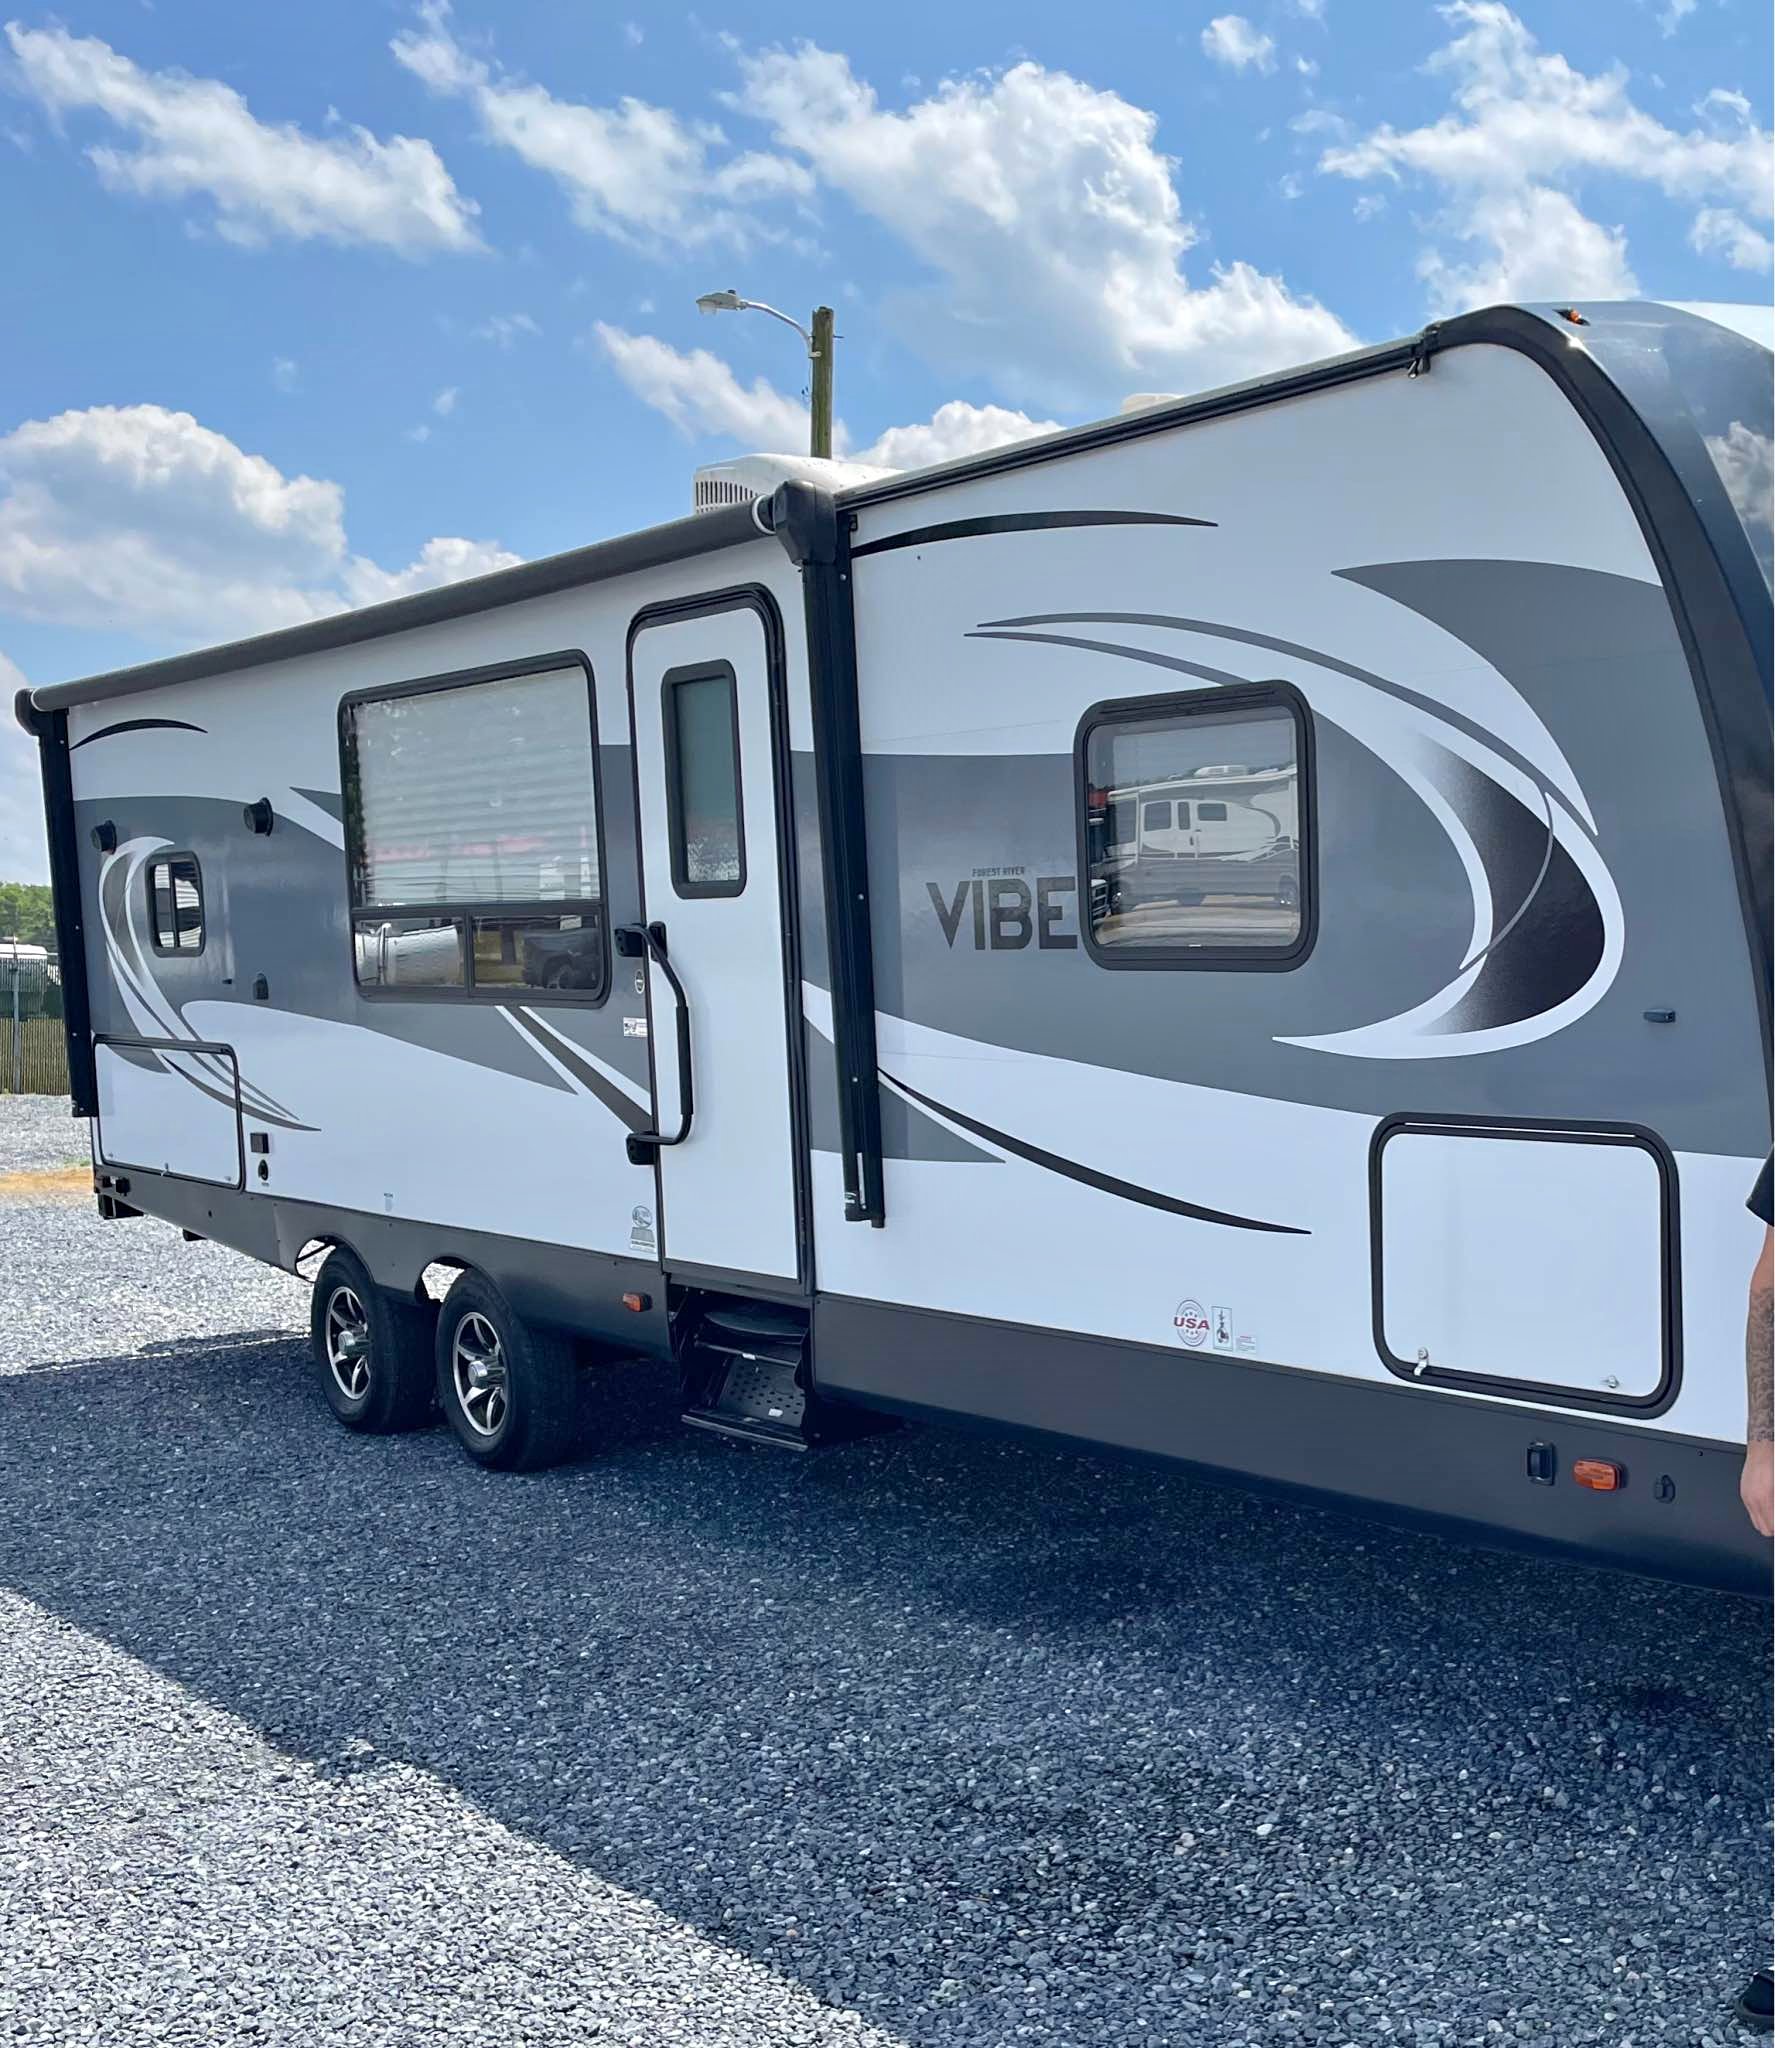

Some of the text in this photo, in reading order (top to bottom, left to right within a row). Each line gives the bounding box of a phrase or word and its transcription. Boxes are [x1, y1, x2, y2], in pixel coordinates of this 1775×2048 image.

[972, 866, 1025, 877] FOREST RIVER
[926, 876, 1078, 950] VIBE
[1173, 1316, 1210, 1330] USA
